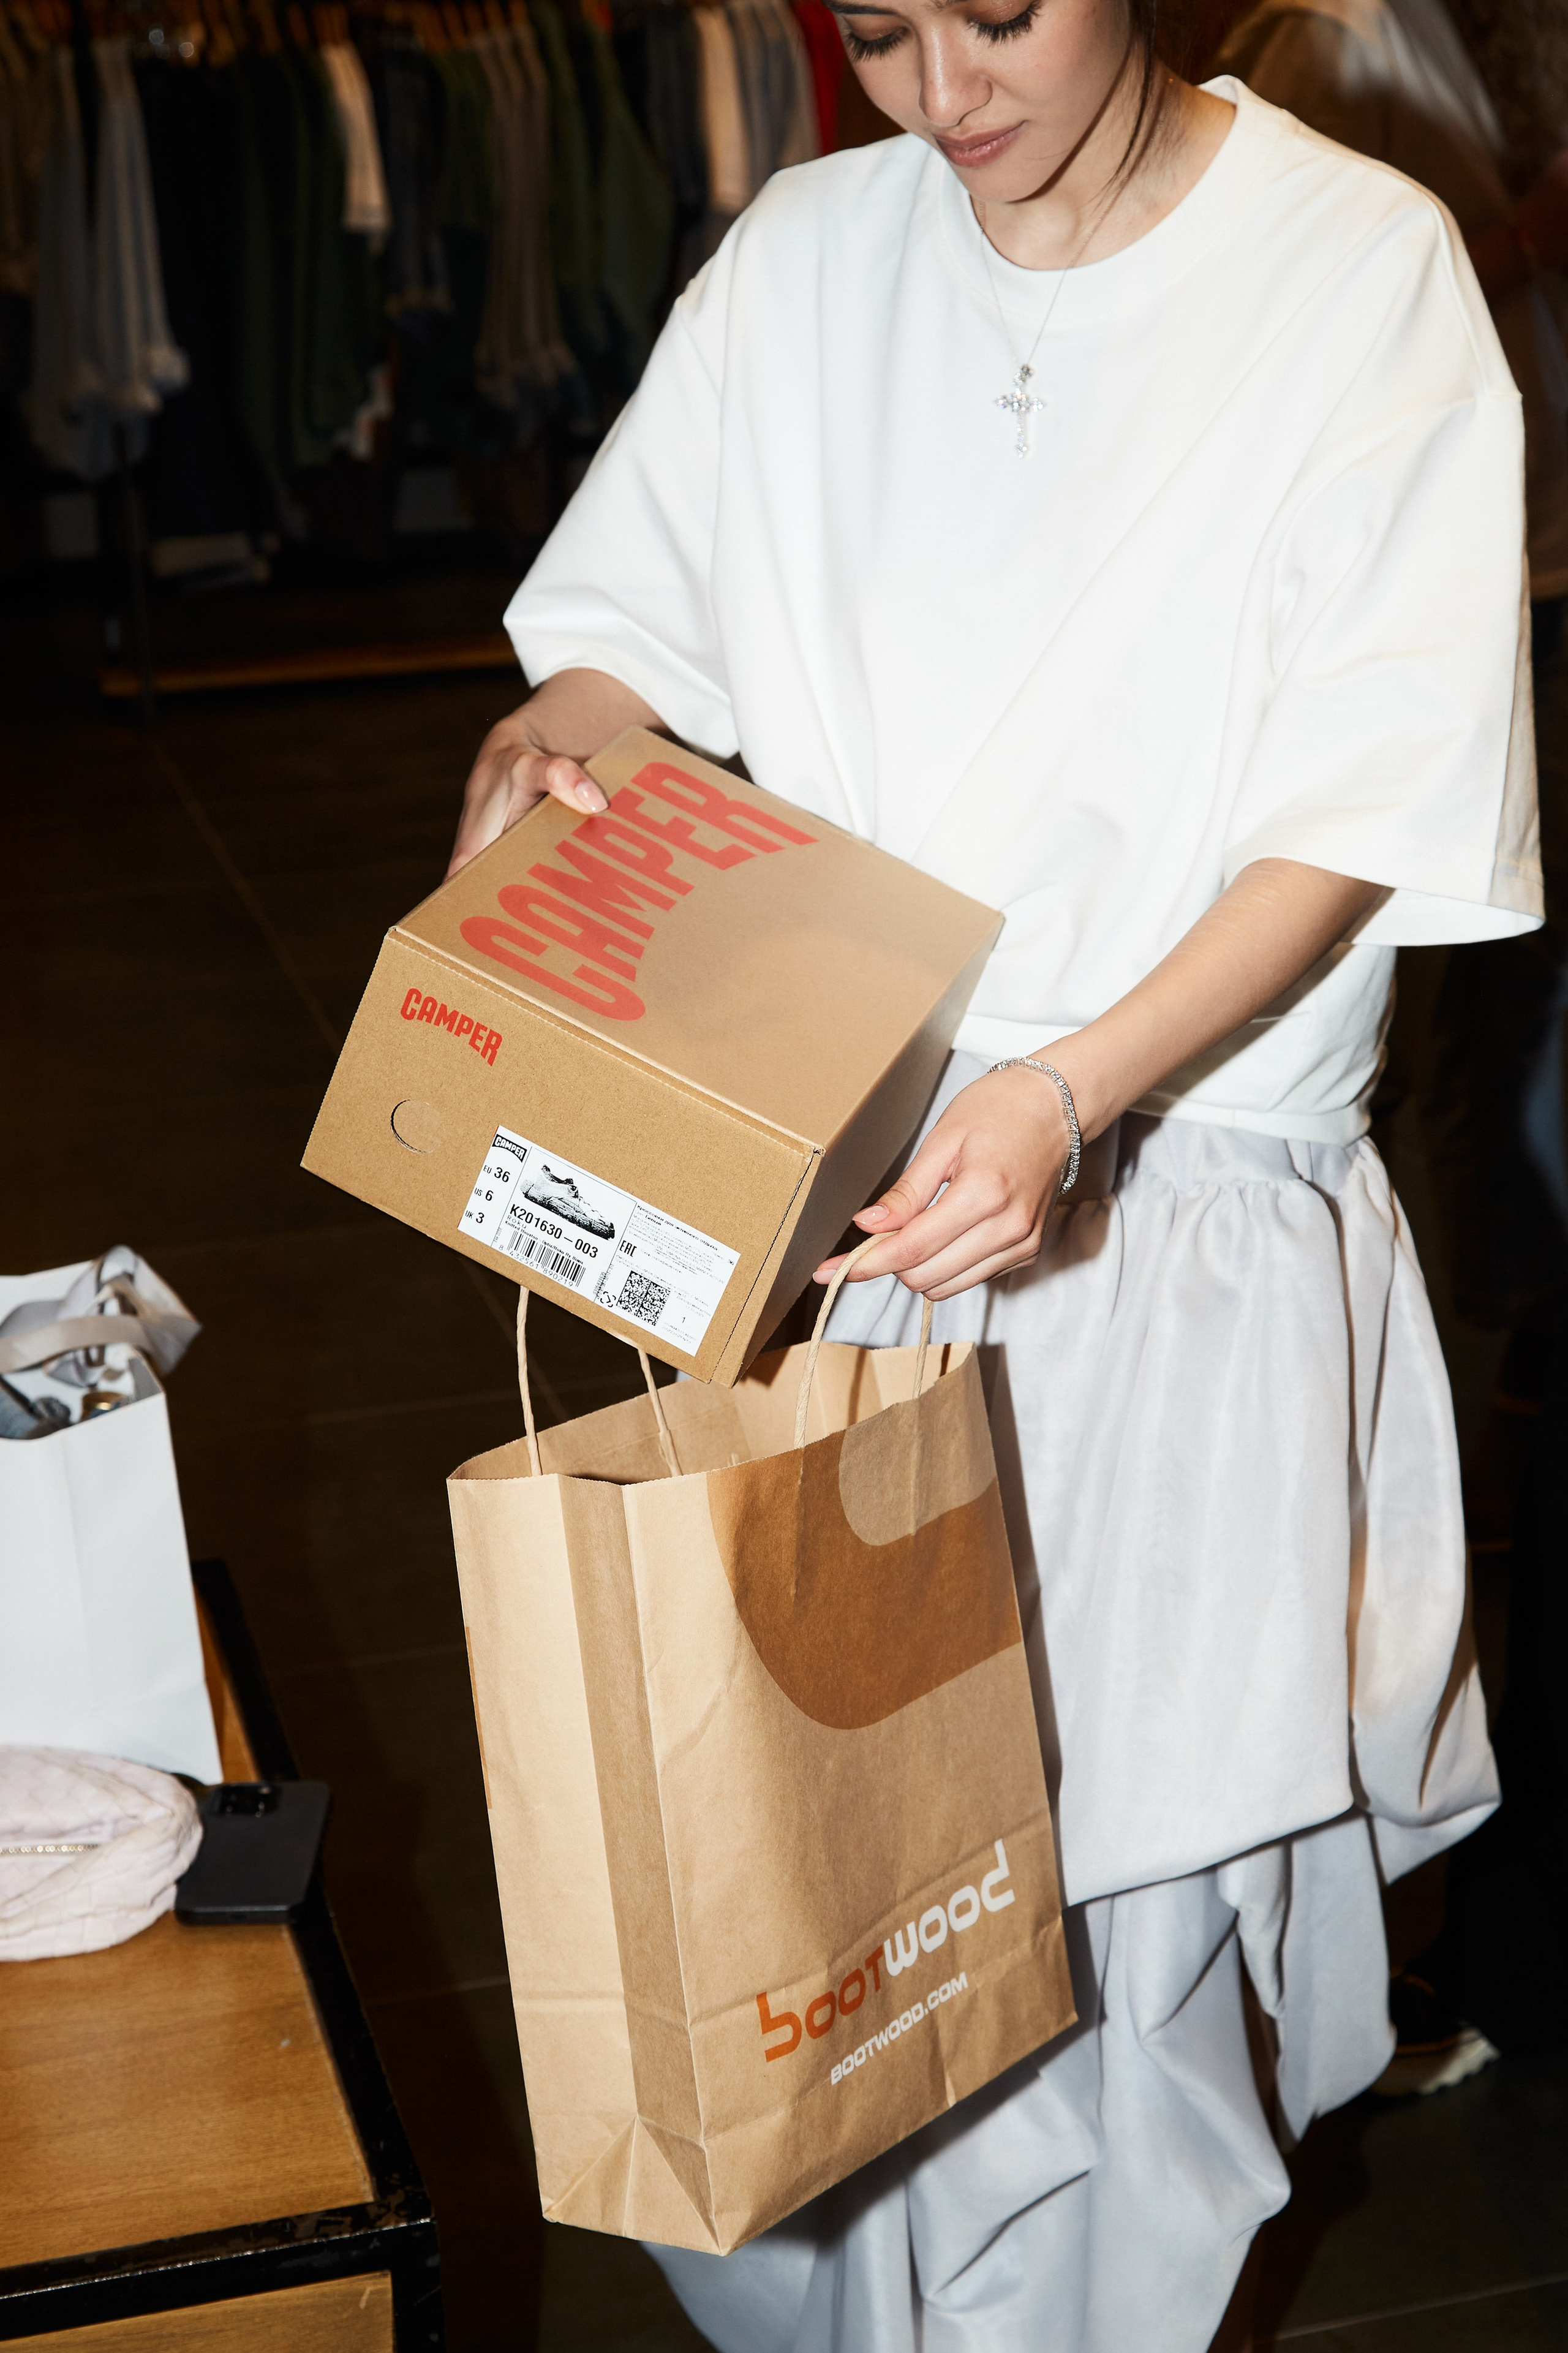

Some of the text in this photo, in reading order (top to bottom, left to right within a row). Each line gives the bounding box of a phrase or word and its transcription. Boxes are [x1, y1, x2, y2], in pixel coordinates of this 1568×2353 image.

[459, 761, 820, 1021] CAMPER
[400, 988, 503, 1067] CAMPER
[494, 1136, 524, 1160] CAMPER
[483, 1165, 510, 1182] EU 36
[474, 1187, 493, 1201] US 6
[465, 1210, 484, 1223] UK 3
[507, 1214, 526, 1228] Roku
[510, 1203, 562, 1239] K201630
[575, 1238, 598, 1258] 003
[619, 1239, 637, 1257] EAC
[509, 1250, 538, 1269] 432561
[542, 1267, 573, 1286] 890219
[831, 1971, 968, 2085] BOOTWOOD.COM
